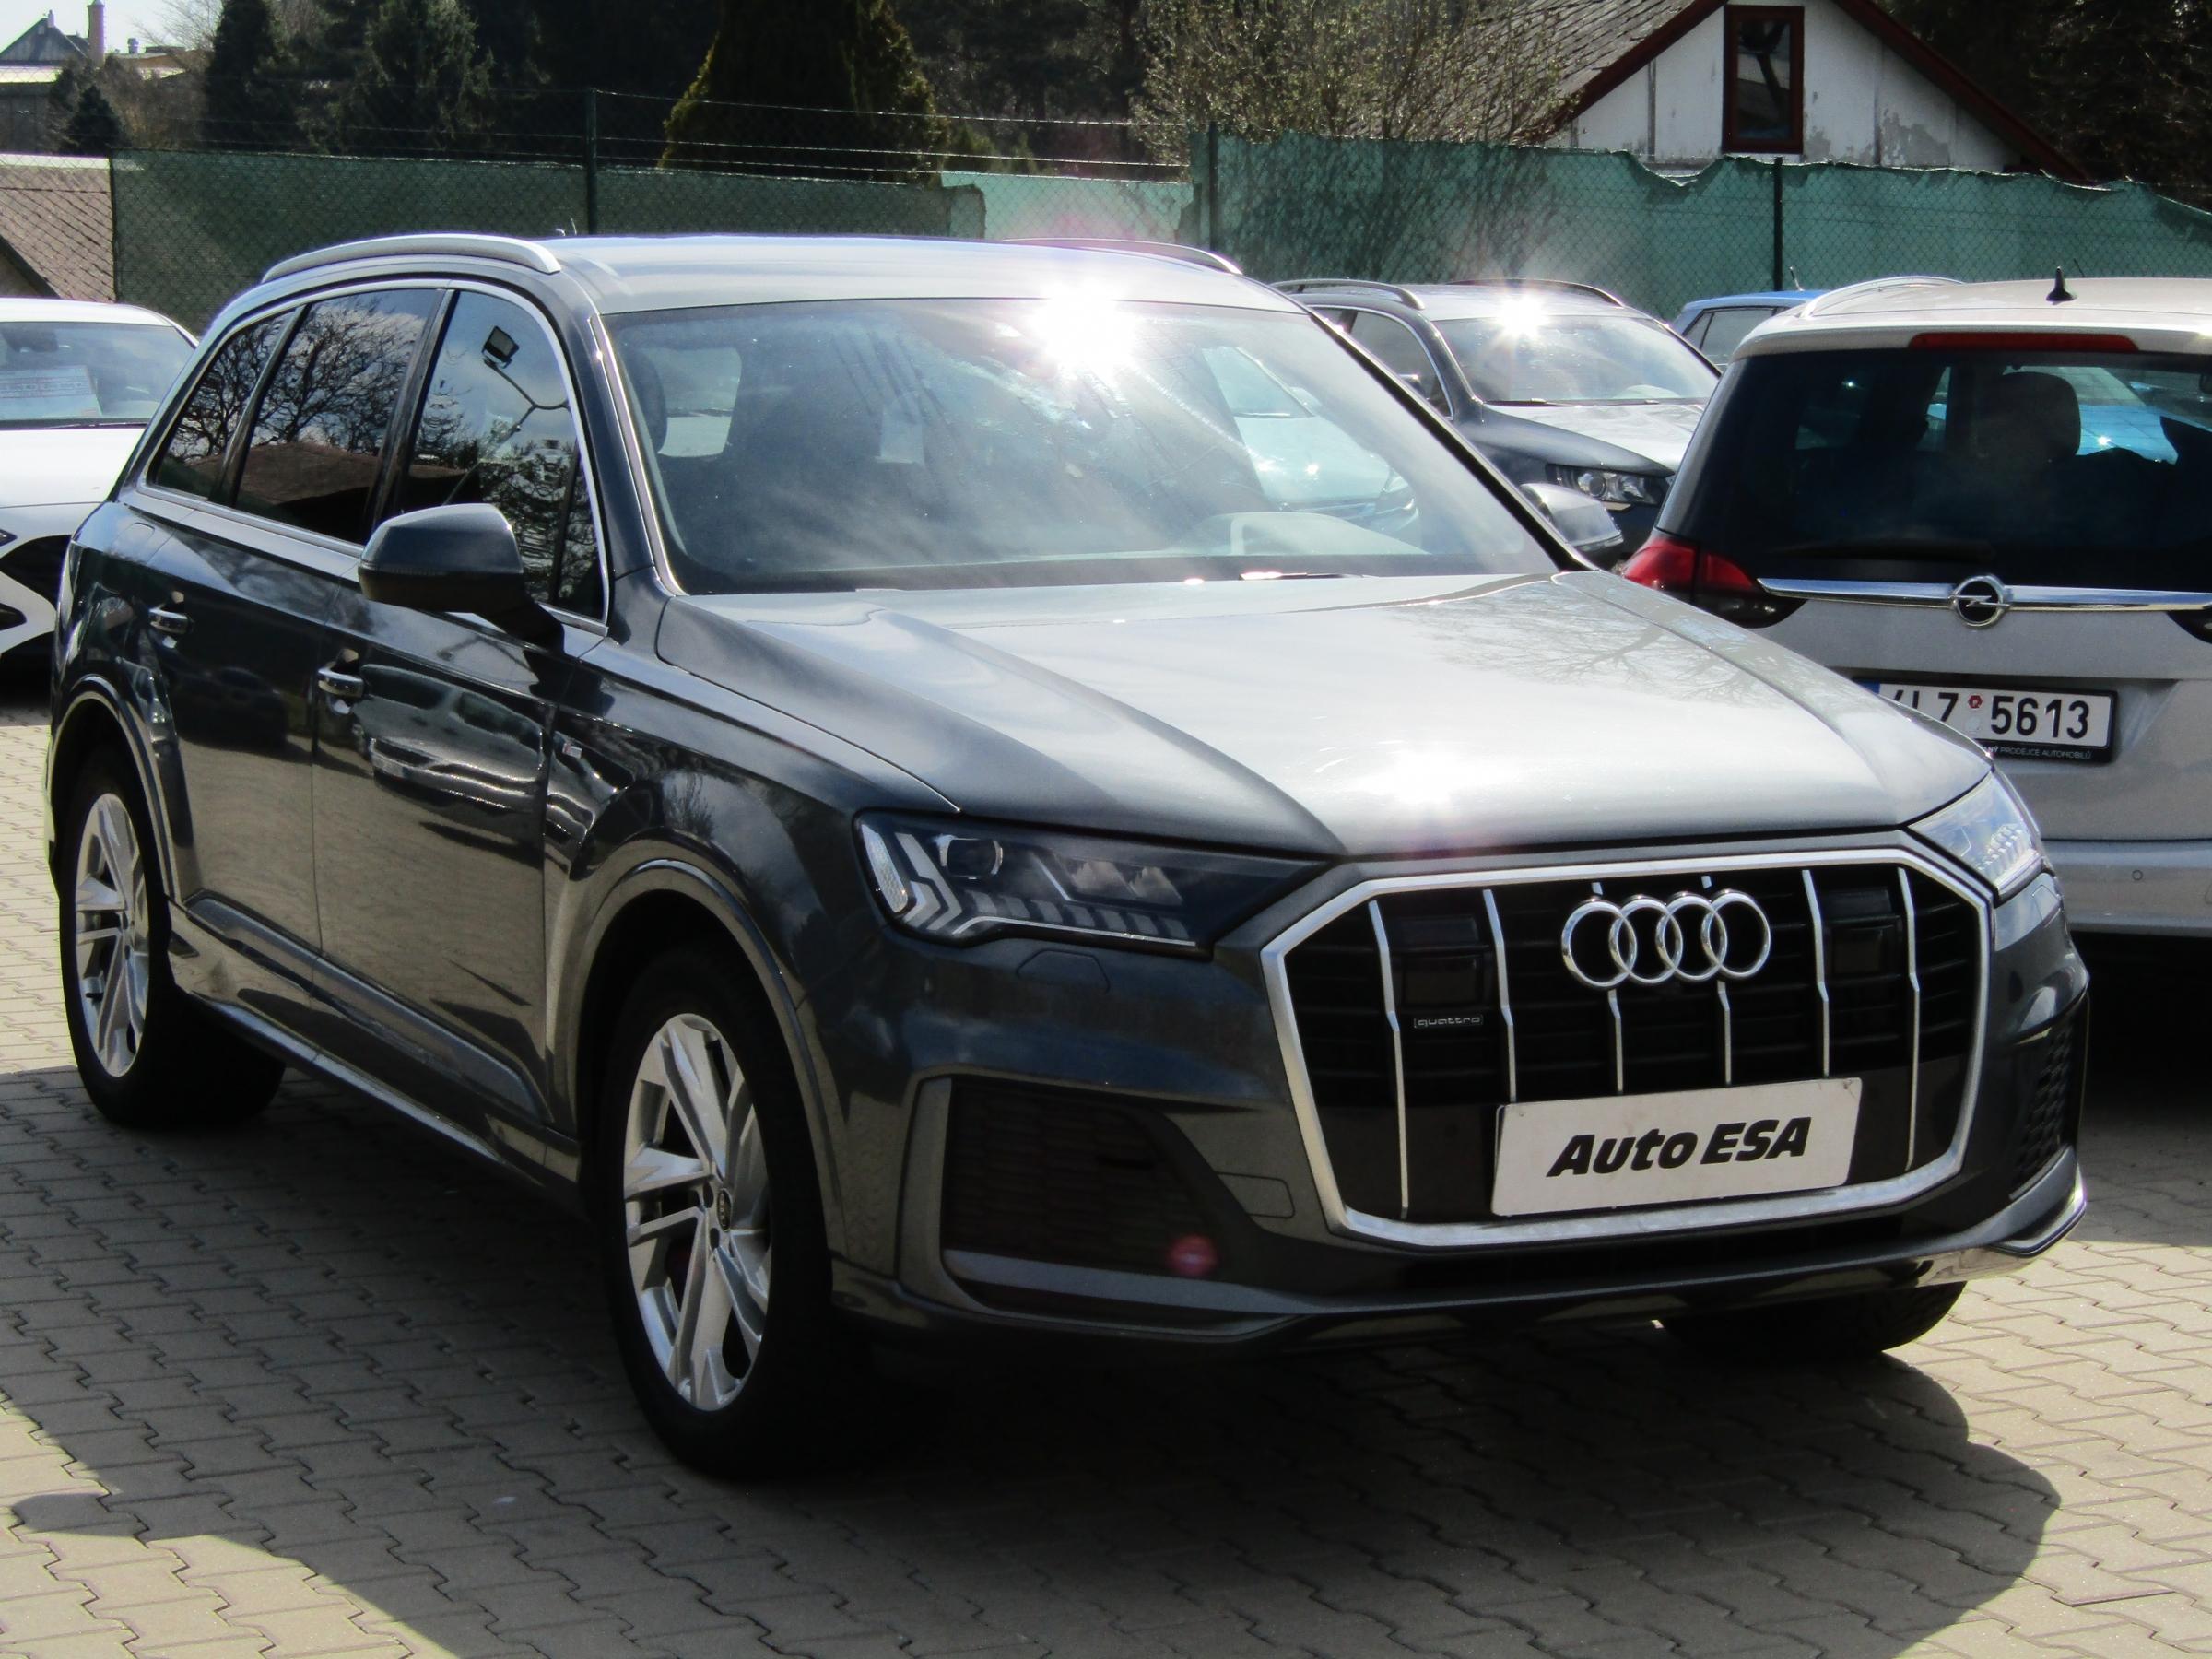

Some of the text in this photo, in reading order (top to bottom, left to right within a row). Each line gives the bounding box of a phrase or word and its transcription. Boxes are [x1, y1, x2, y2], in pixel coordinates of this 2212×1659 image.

[1991, 695, 2089, 739] 5613
[1418, 1017, 1481, 1028] quattro
[1547, 1116, 1812, 1177] Auto ESA
